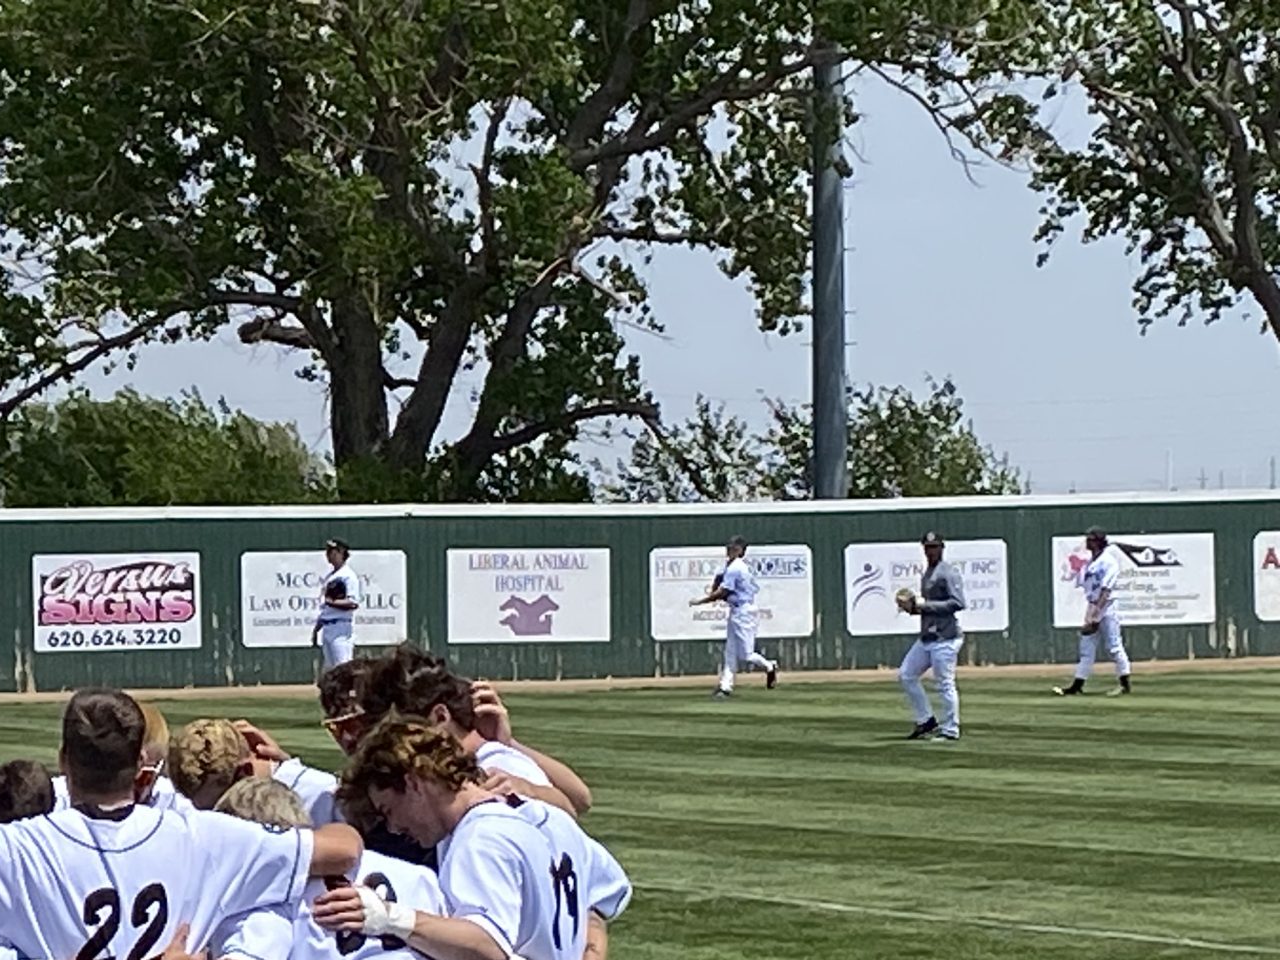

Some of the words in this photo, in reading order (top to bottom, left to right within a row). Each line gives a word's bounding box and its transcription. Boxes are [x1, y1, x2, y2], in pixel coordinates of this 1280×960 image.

[468, 554, 529, 570] LIBERAL
[533, 553, 589, 569] ANIMAL
[43, 559, 191, 598] Versus
[495, 575, 564, 592] HOSPITAL
[40, 590, 195, 625] SIGNS
